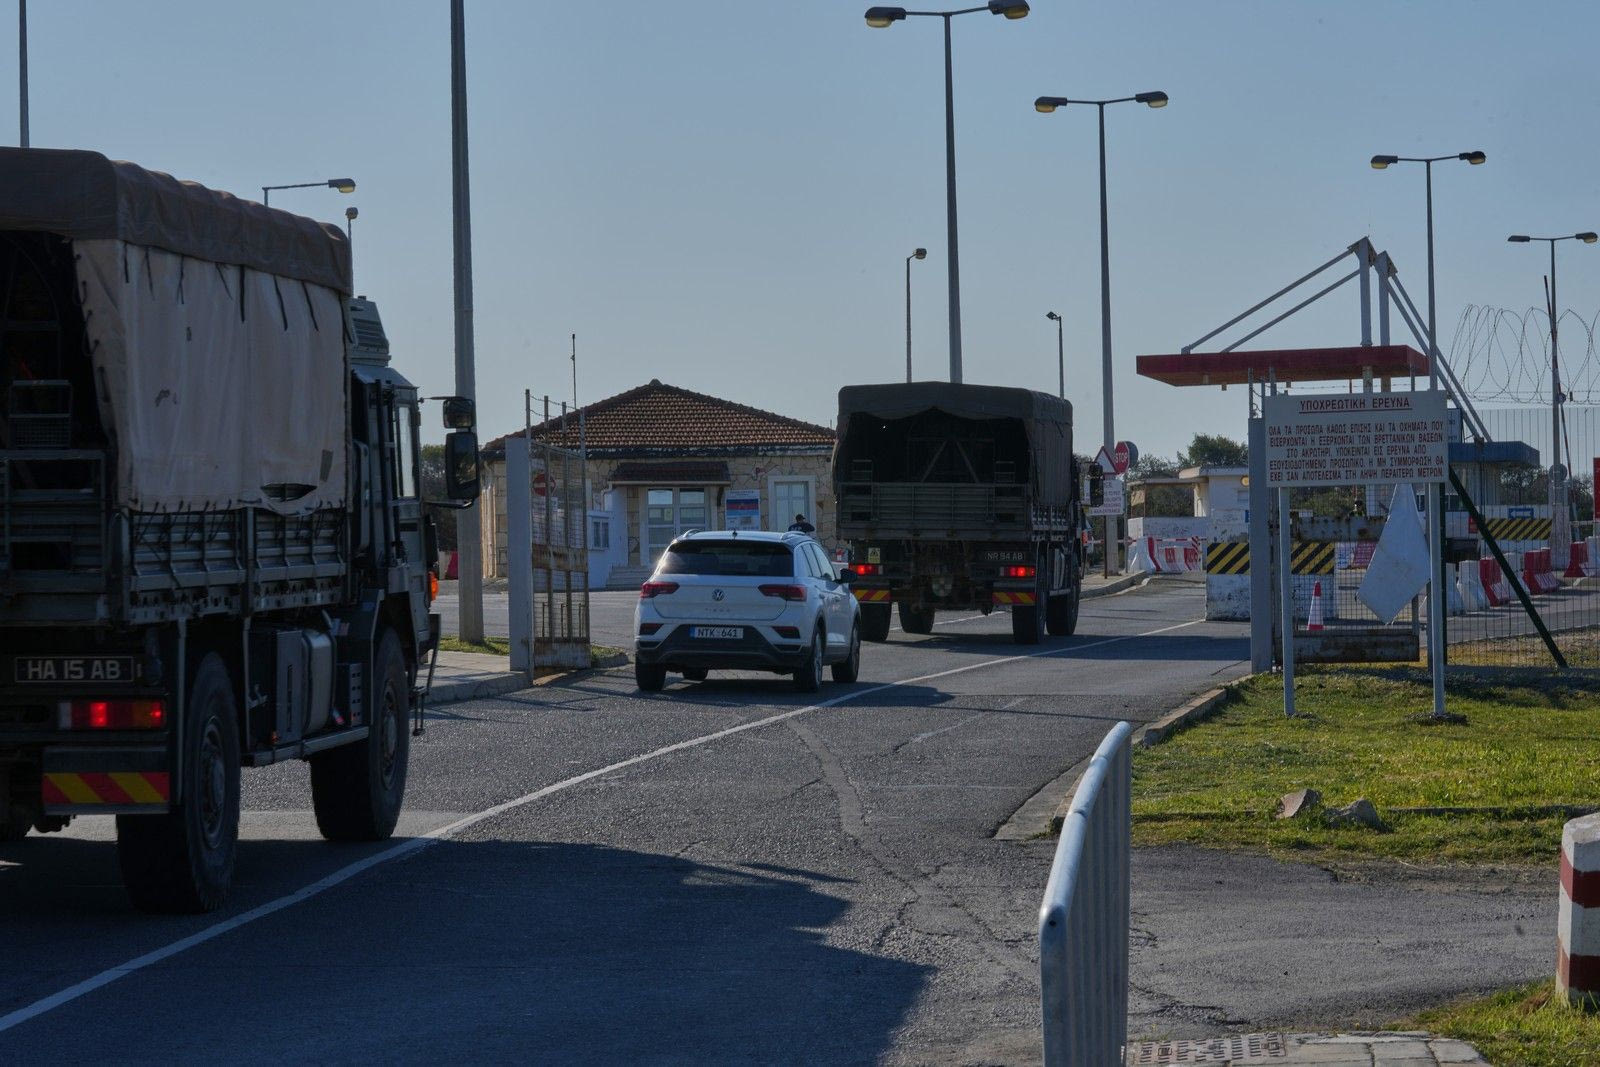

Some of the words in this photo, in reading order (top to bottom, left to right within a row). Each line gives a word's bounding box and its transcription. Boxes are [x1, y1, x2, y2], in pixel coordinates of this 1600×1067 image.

[1300, 398, 1366, 410] ΥΠΟΧΡΕΩΤΙΚΗ
[1372, 397, 1410, 408] ΕΡΕΥΝΑ
[1285, 425, 1292, 435] ΤΑ
[1296, 424, 1323, 435] ΠΡΟΣΩΠΑ
[1327, 424, 1346, 434] ΚΑΘΩΣ
[1351, 423, 1371, 433] ΕΠΙΣΗΣ
[1375, 422, 1385, 432] ΚΑΙ
[1389, 422, 1396, 431] ΤΑ
[1400, 421, 1427, 431] ΟΧΗΜΑΤΑ
[1432, 421, 1443, 431] ΠΟΥ
[1270, 436, 1308, 447] ΕΙΣΕΡΧΟΝΤΑΙ
[1311, 437, 1315, 446] Η
[1319, 435, 1354, 446] ΕΞΕΡΧΟΝΤΑΙ
[1358, 434, 1370, 444] ΤΩΝ
[1419, 432, 1443, 443] ΒΑΣΕΩΝ
[1114, 452, 1128, 463] STOP
[1287, 448, 1298, 458] ΣΤΟ
[1336, 446, 1370, 456] ΥΠΟΚΕΙΝΤΑΙ
[1374, 446, 1383, 455] ΕΙΣ
[1387, 445, 1410, 455] ΕΡΕΥΝΑ
[1414, 445, 1426, 454] ΑΠΟ
[1270, 459, 1326, 470] ΕΞΟΥΣΙΟΔΟΤΗΜΕΝΟ
[1377, 457, 1386, 466] ΜΗ
[1390, 456, 1431, 466] ΣΥΜΜΟΡΦΩΣΗ
[1436, 456, 1444, 465] ΘΑ
[1270, 472, 1283, 481] ΕΧΕΙ
[1287, 471, 1299, 481] ΣΑΝ
[1303, 470, 1341, 480] ΑΠΟΤΕΛΕΣΜΑ
[1345, 469, 1356, 479] ΣΤΗ
[1360, 468, 1377, 479] ΛΗΨΗ
[1381, 467, 1414, 478] ΠΕΡΑΙΤΕΡΩ
[698, 628, 715, 637] NTK
[722, 629, 737, 637] 641
[28, 660, 56, 679] HA
[63, 660, 85, 679] 15
[91, 660, 120, 679] AB
